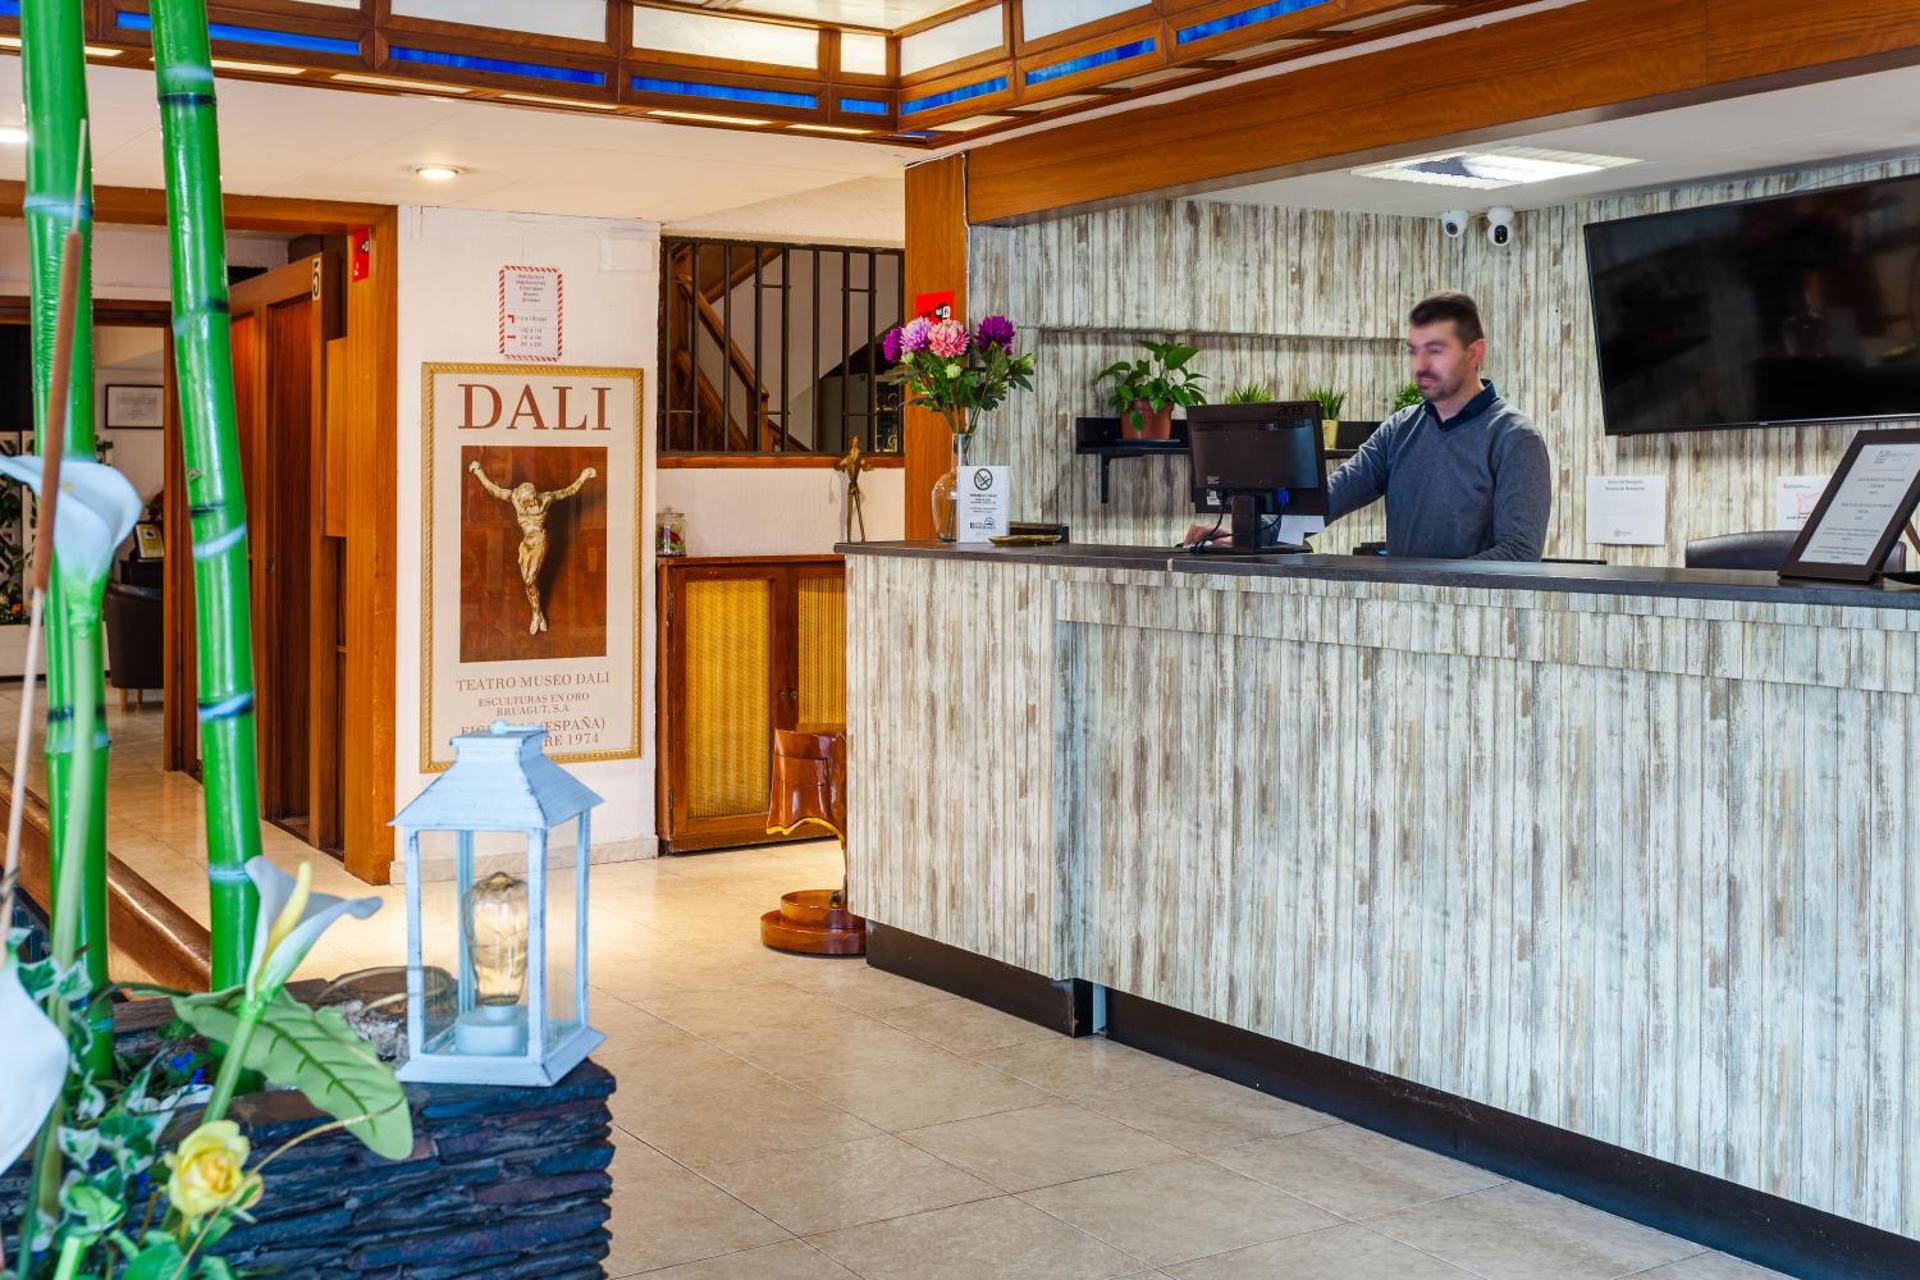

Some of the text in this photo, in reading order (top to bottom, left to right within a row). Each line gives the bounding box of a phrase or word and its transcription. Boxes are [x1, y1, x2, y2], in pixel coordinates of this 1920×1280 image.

[312, 259, 321, 298] 5
[457, 383, 612, 431] DALI
[456, 671, 610, 692] TEATRO MUSEO DALI
[478, 692, 591, 708] ESCULTURAS EN ORO
[566, 732, 600, 747] 1974
